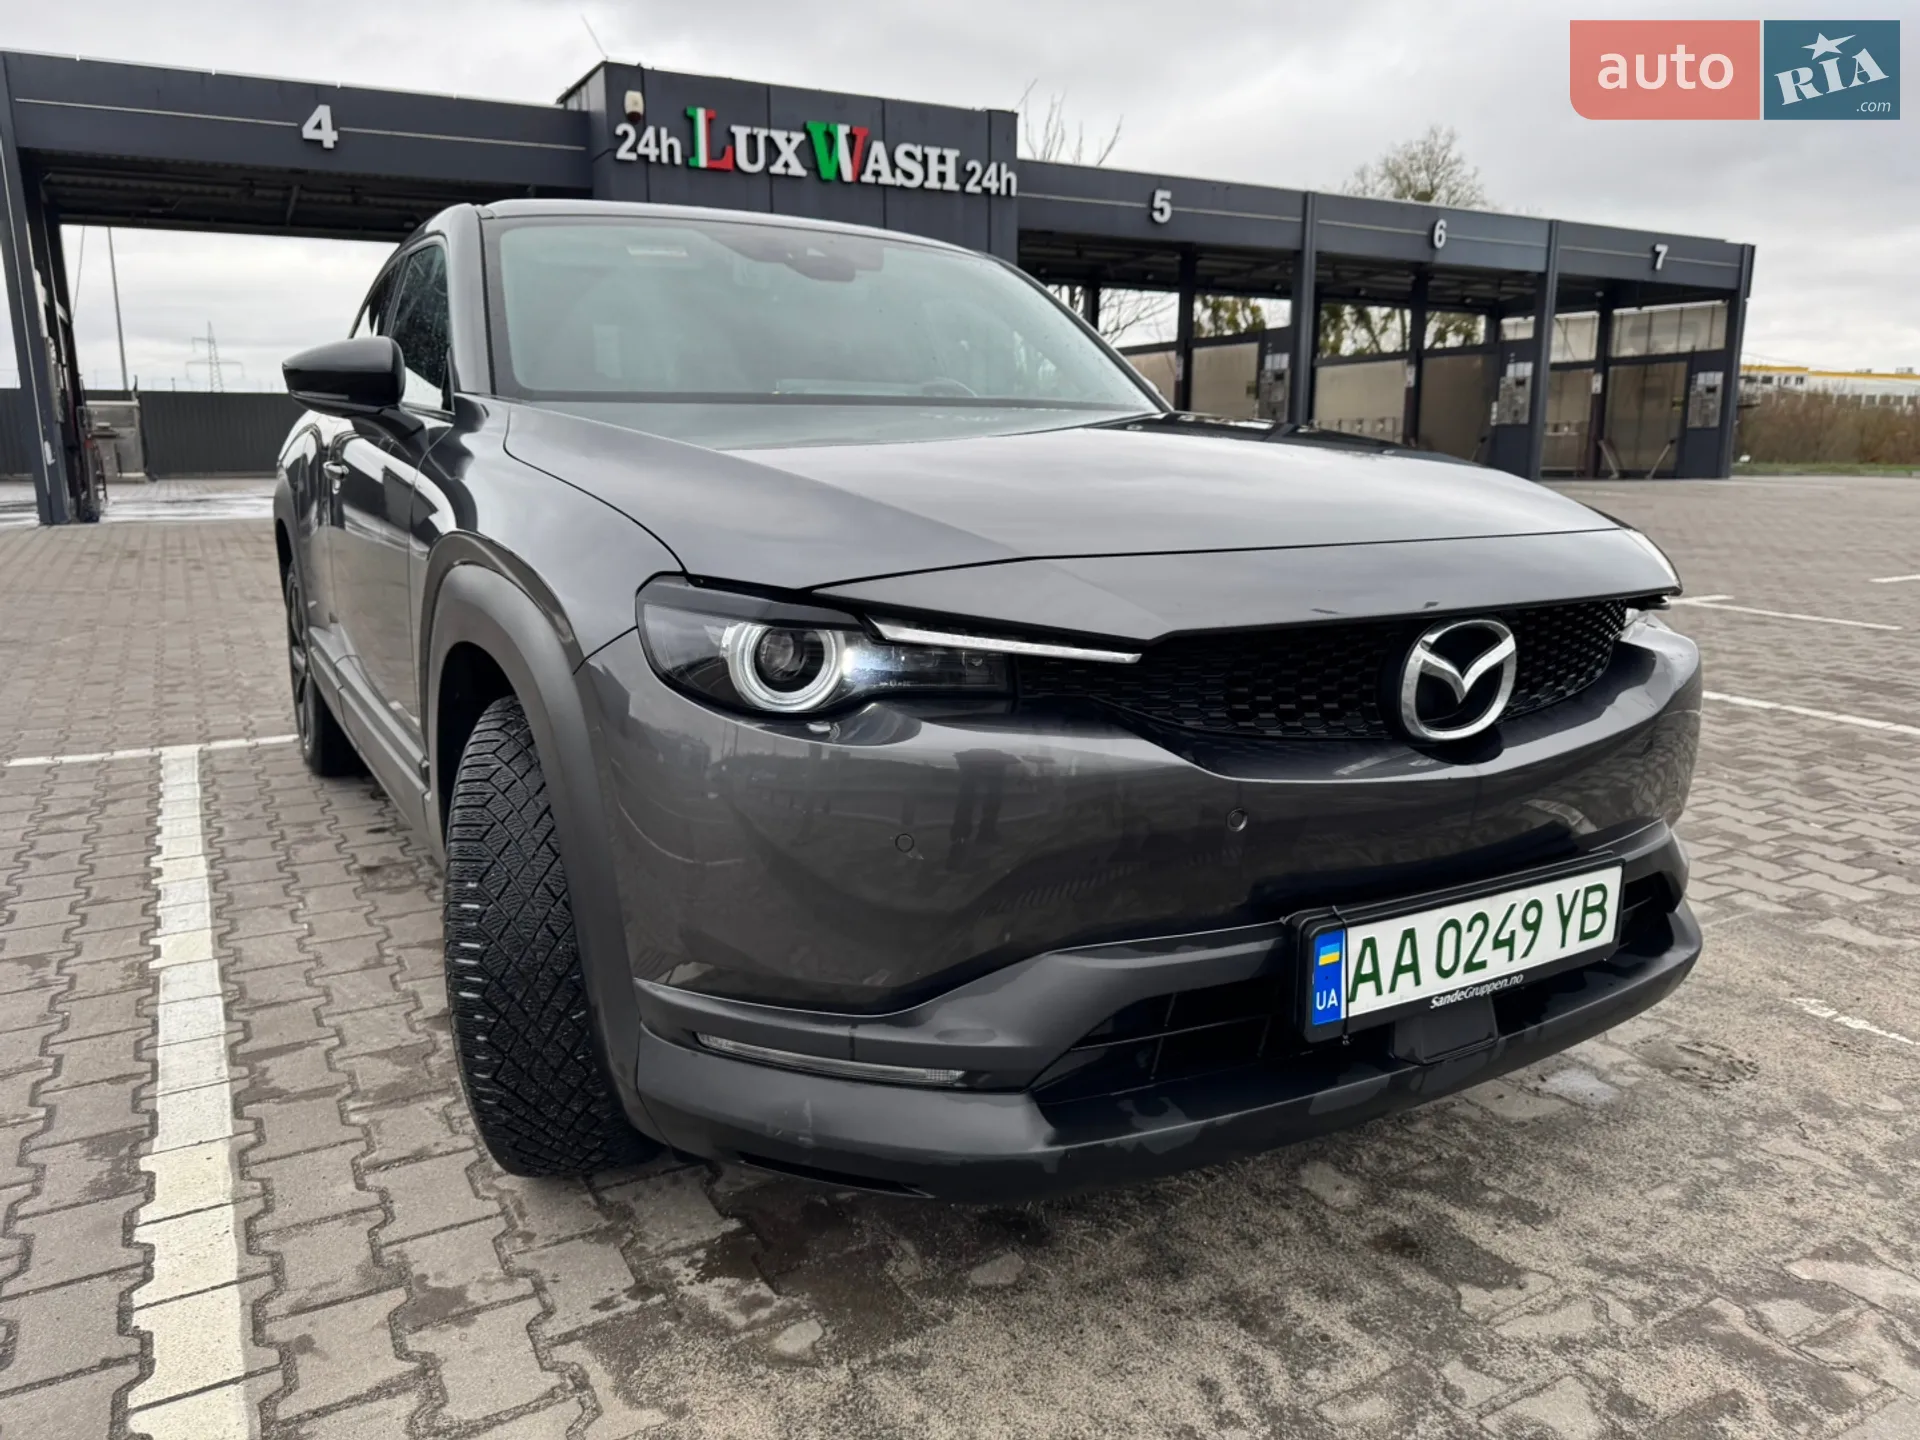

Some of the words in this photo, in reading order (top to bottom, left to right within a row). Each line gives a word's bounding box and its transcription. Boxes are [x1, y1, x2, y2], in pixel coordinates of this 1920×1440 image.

[302, 104, 338, 148] 4
[615, 124, 682, 165] 24h
[965, 160, 1018, 196] 24h
[1152, 189, 1172, 223] 5
[1434, 218, 1447, 249] 6
[1655, 243, 1669, 271] 7
[1349, 927, 1421, 1003] AA
[1435, 898, 1543, 979] 0249
[1556, 883, 1608, 949] YB
[1316, 989, 1338, 1011] UA
[1429, 973, 1524, 1009] SandeGruppen.no
